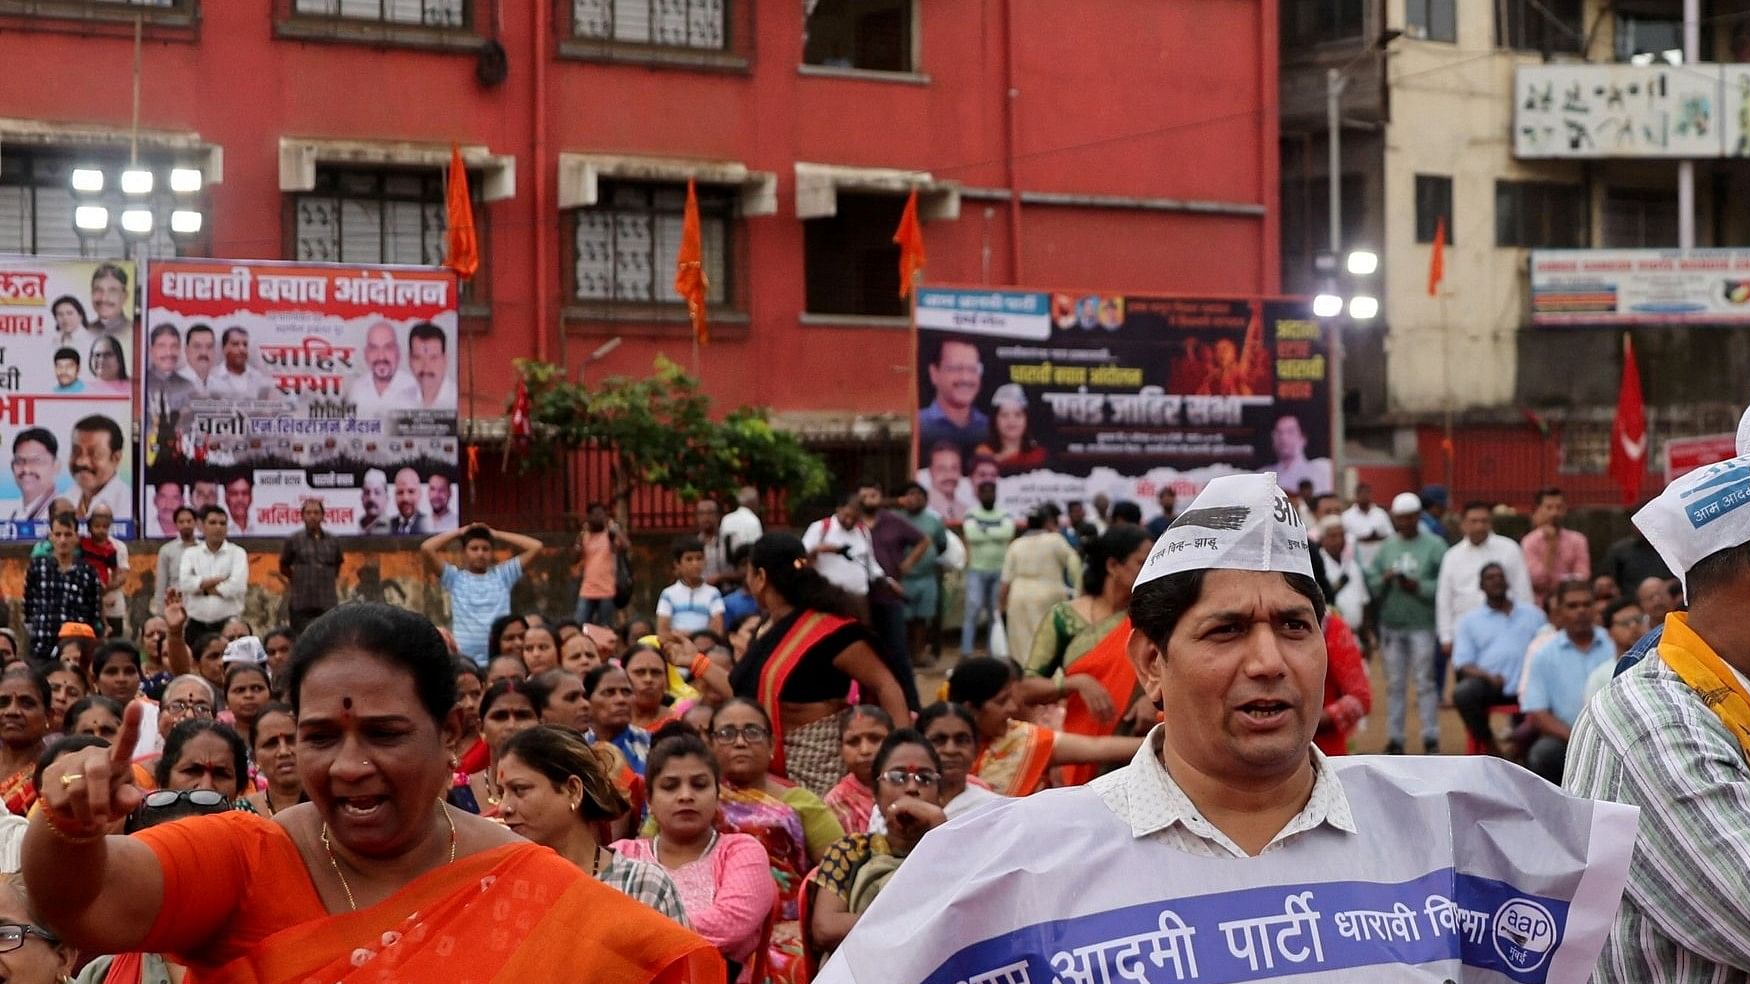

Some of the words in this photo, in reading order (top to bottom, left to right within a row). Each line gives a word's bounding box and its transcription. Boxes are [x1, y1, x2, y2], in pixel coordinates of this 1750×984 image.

[161, 266, 251, 302] धारावी
[258, 273, 326, 303] बचाव
[333, 271, 449, 308] आंदोलन
[260, 336, 355, 372] जाहिर
[272, 374, 343, 396] सभा
[1693, 501, 1721, 523] आम
[1219, 891, 1325, 973] पार्टी
[1334, 900, 1420, 944] धारावी
[1507, 908, 1549, 942] aap
